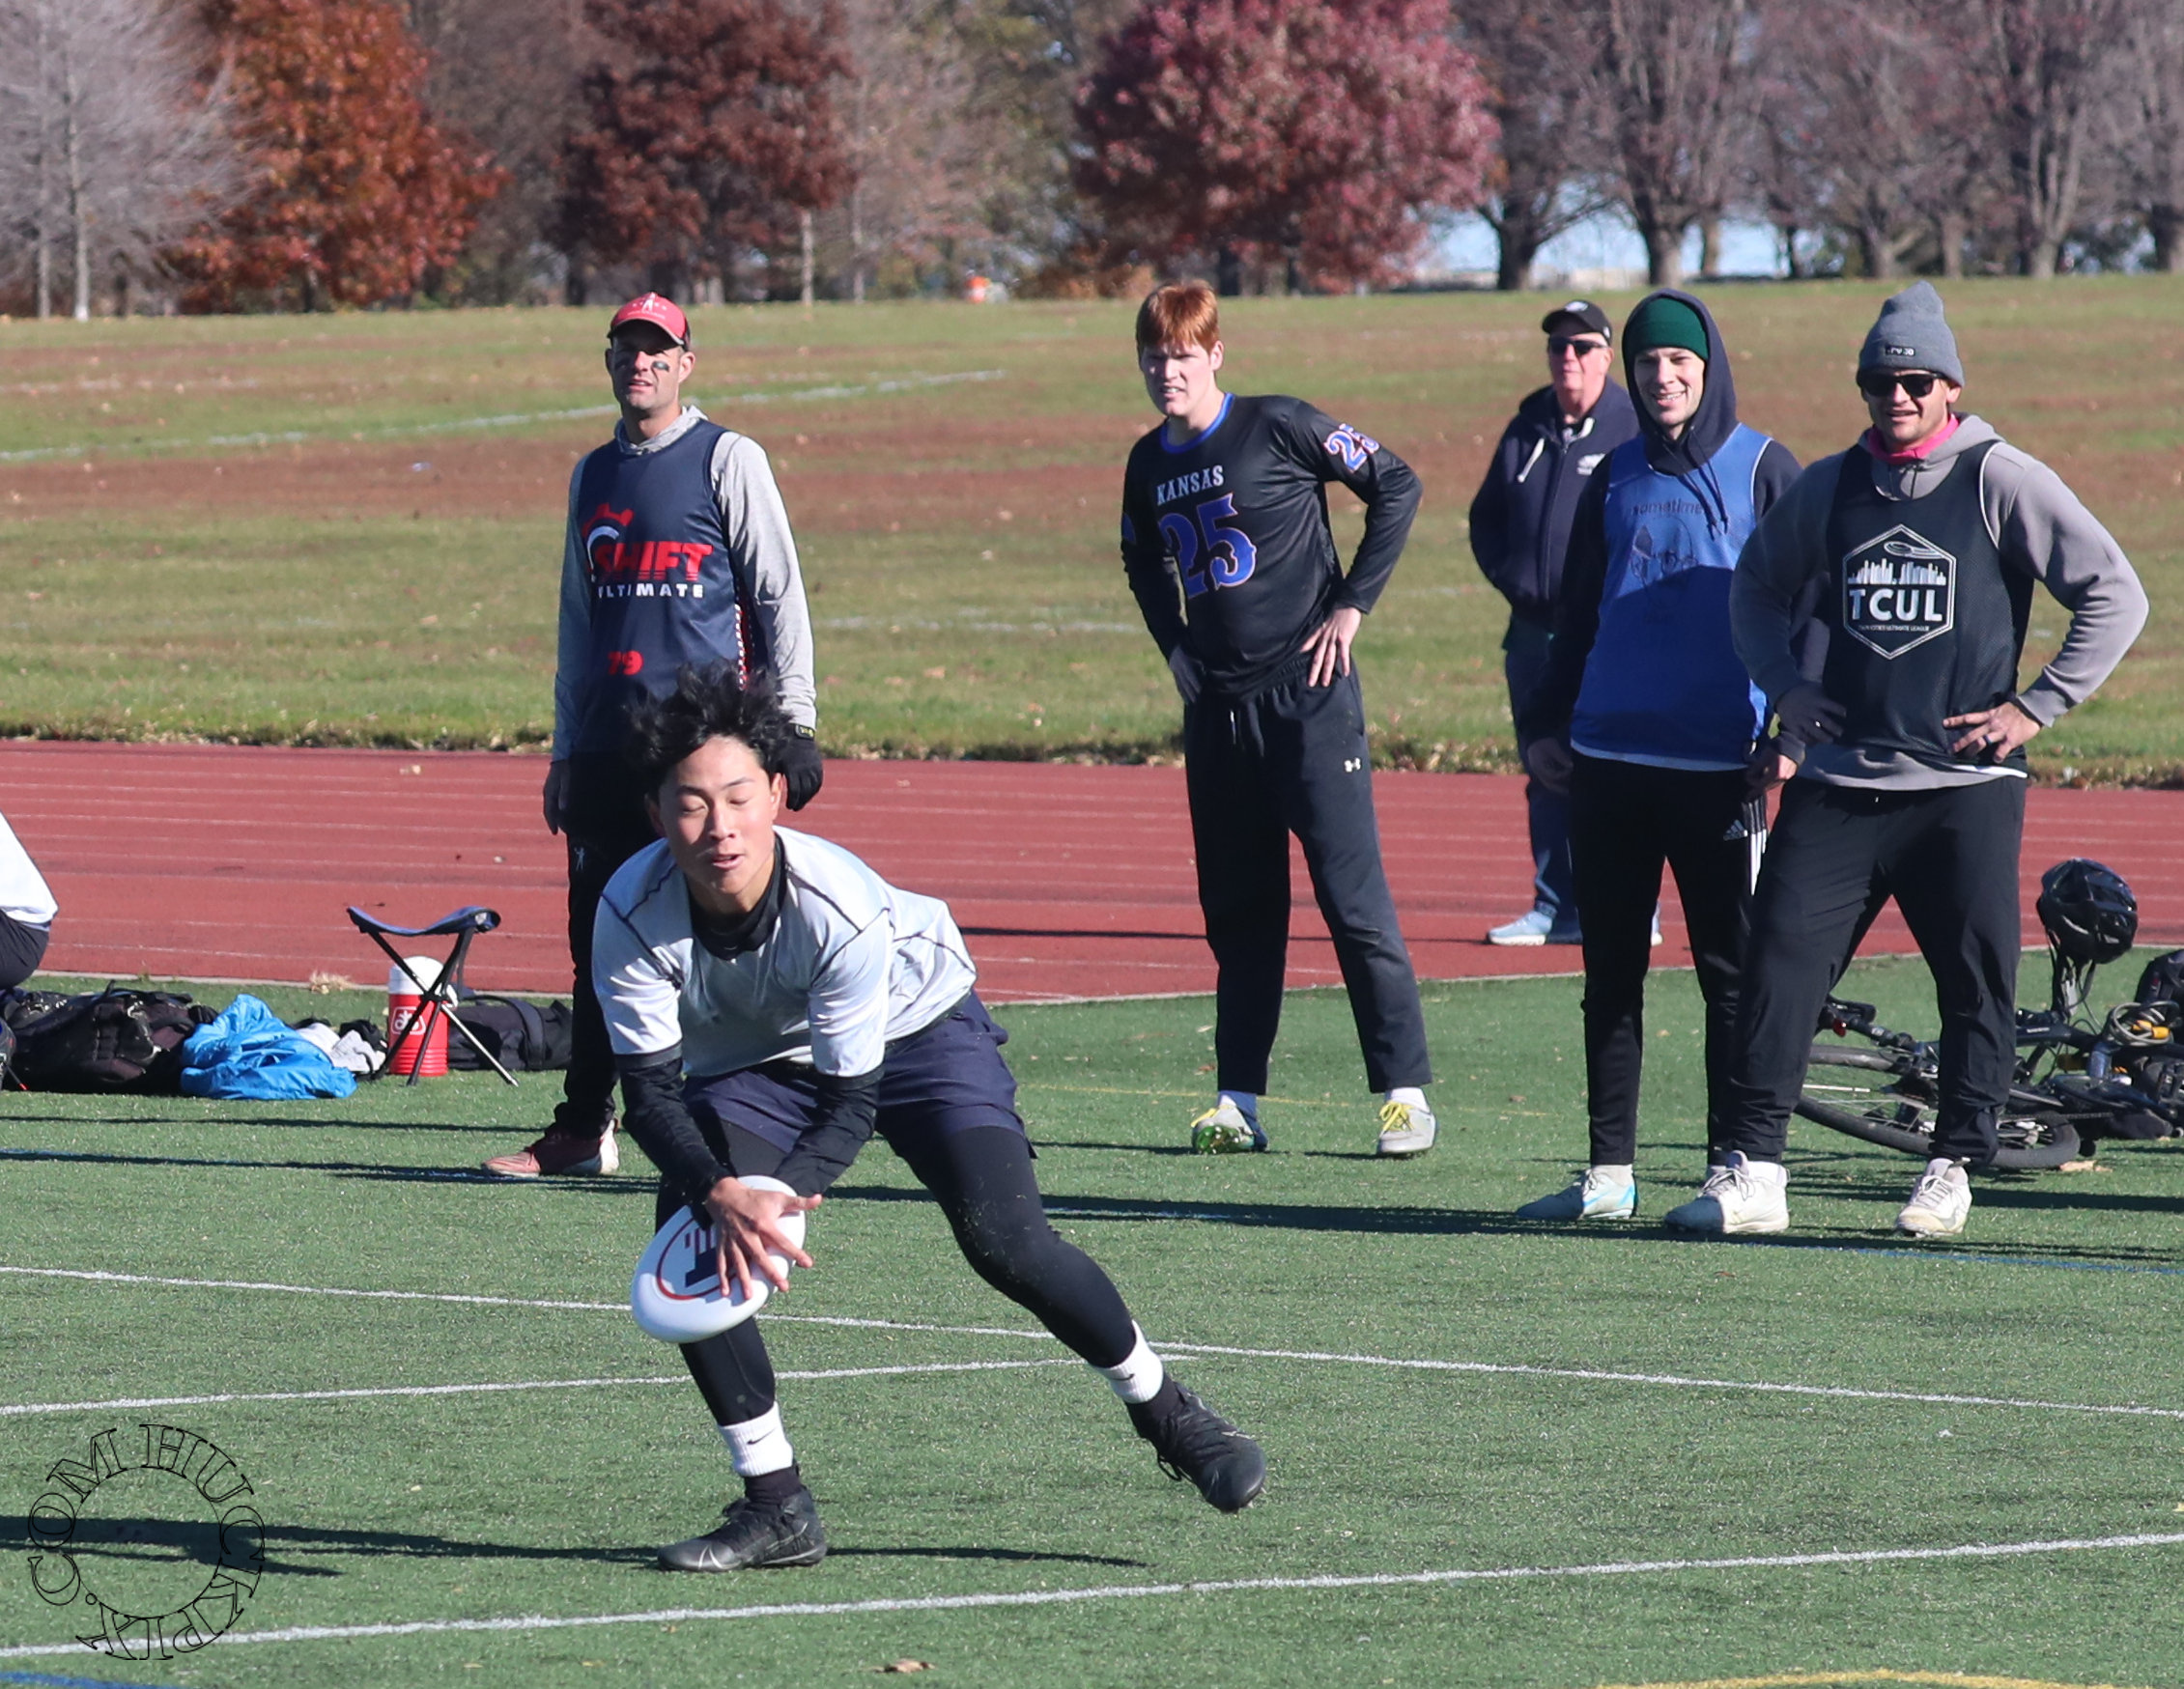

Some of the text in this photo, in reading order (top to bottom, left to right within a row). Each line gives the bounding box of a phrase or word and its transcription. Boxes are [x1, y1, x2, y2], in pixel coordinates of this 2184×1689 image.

[1156, 464, 1224, 505] KANSAS
[594, 541, 714, 581] SHIFT
[1158, 493, 1256, 599] 25
[1849, 588, 1943, 621] TCUL
[608, 650, 643, 675] 79
